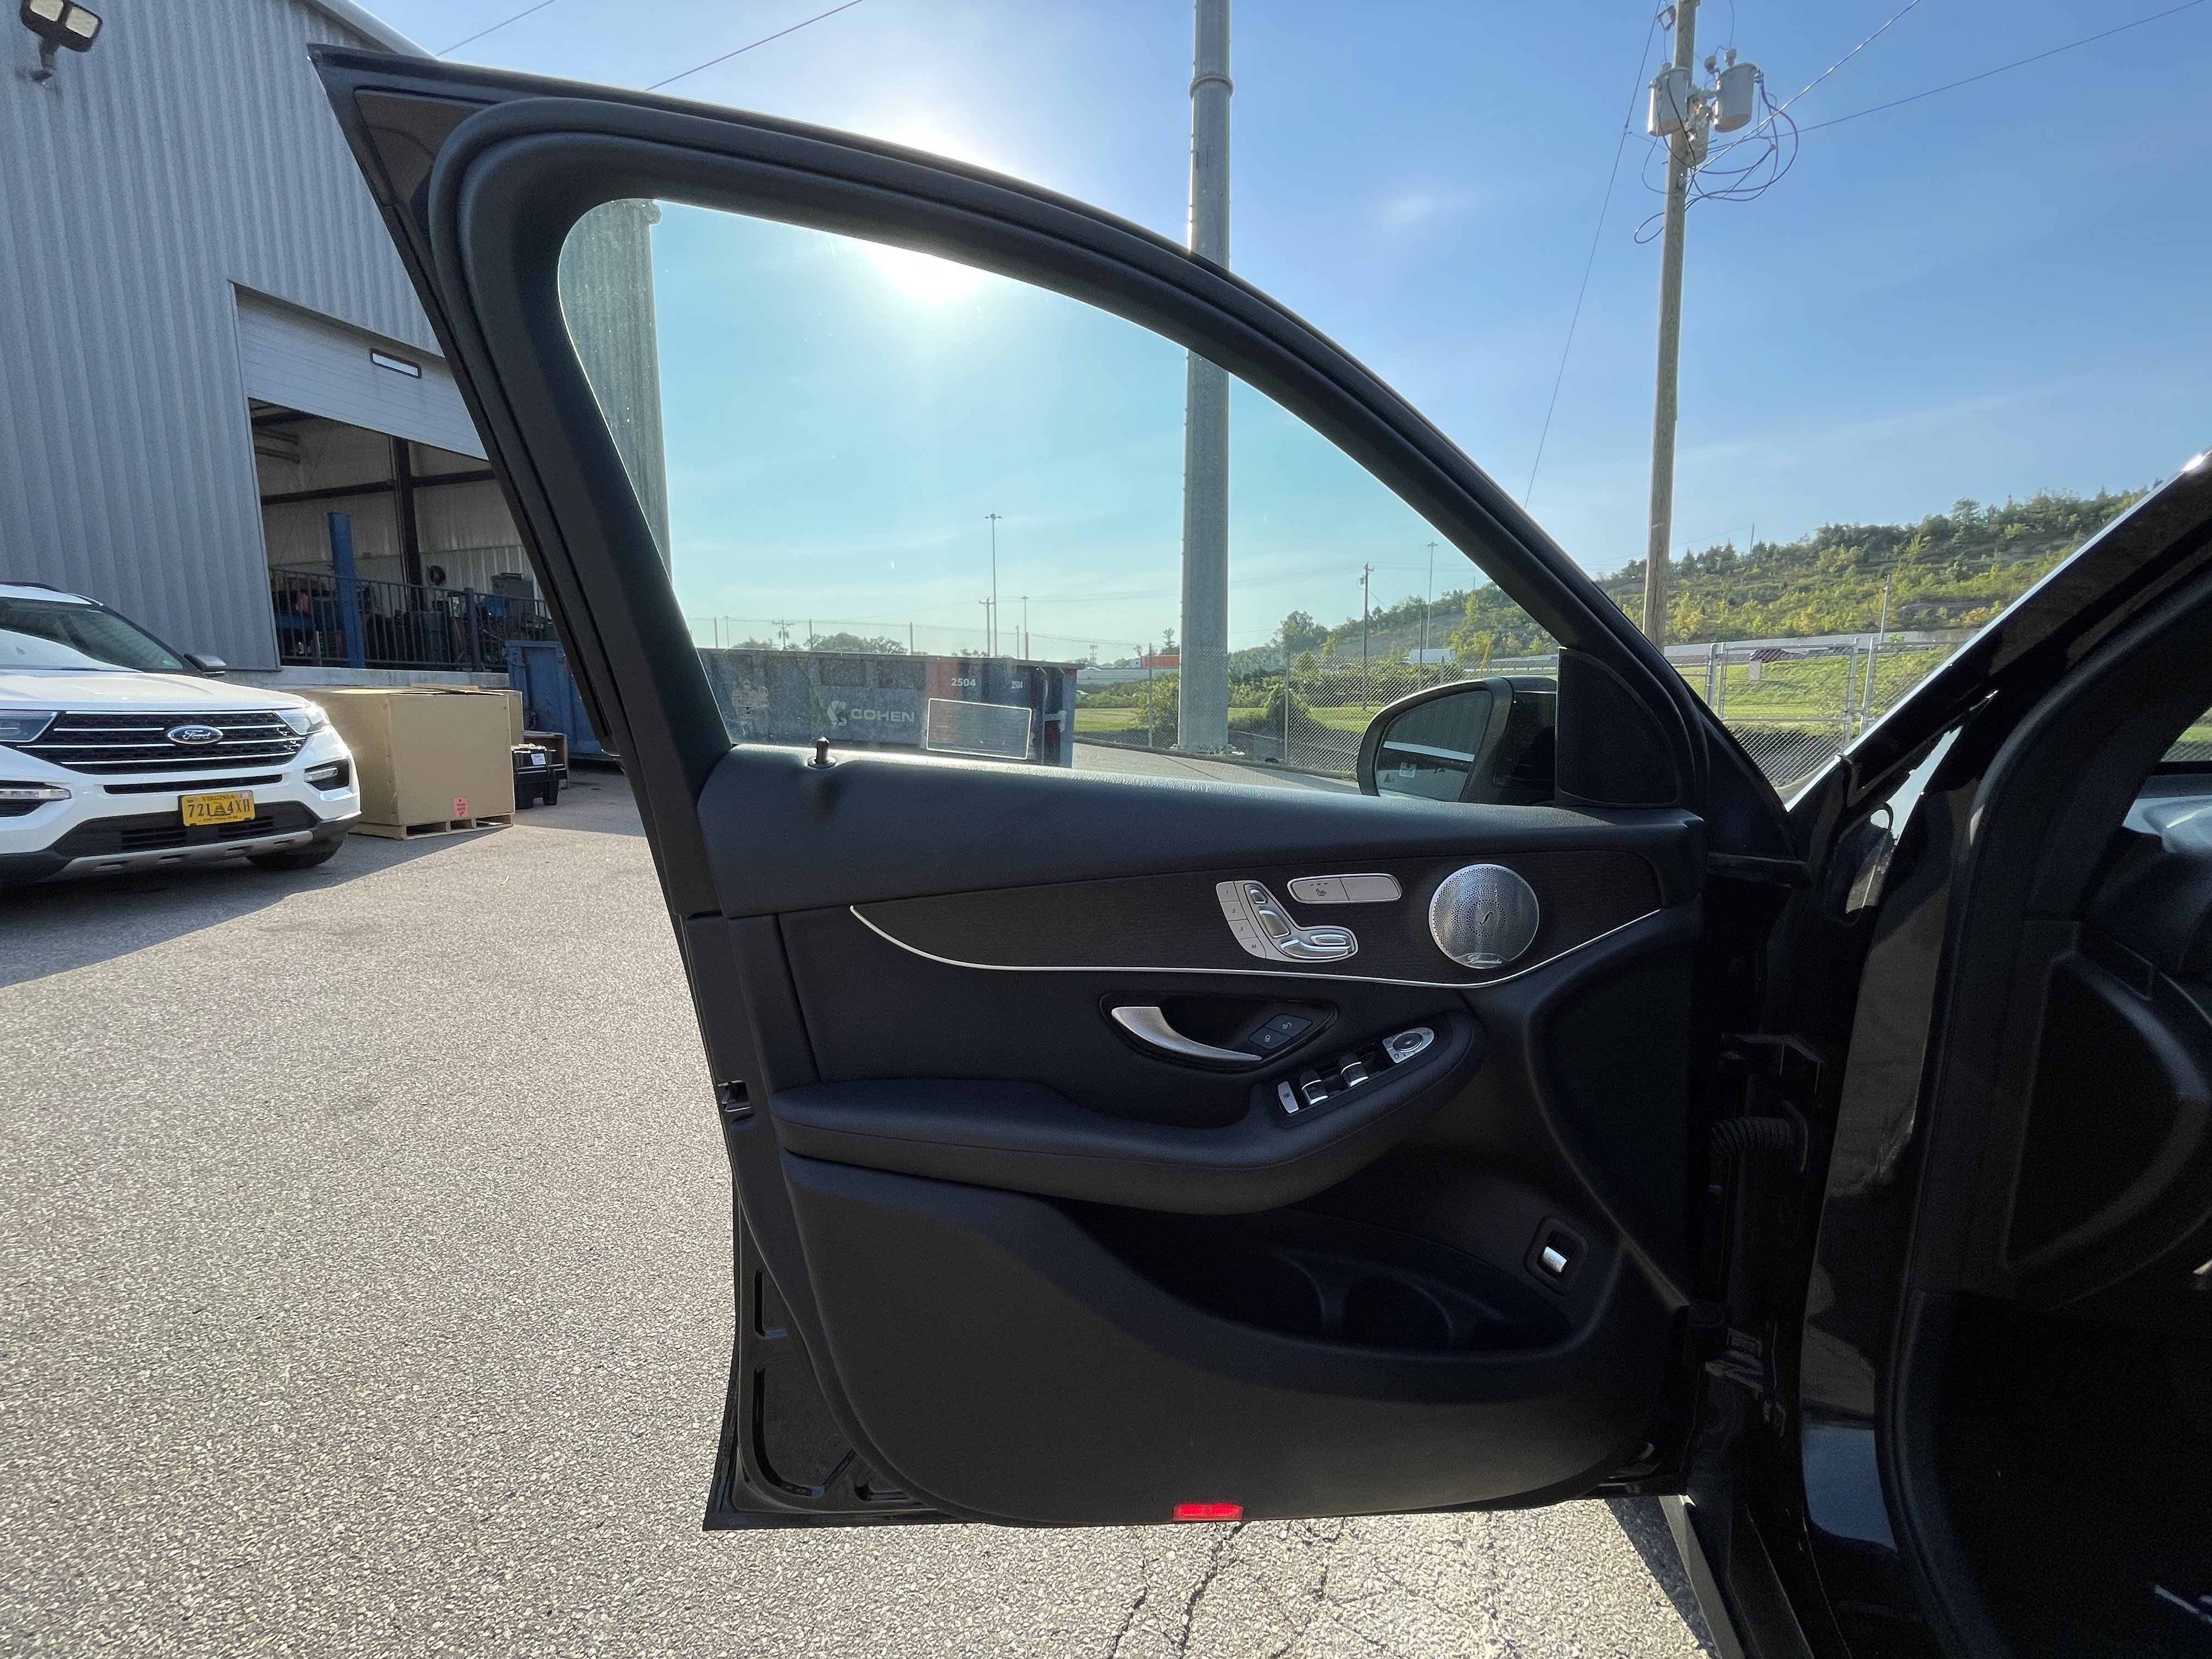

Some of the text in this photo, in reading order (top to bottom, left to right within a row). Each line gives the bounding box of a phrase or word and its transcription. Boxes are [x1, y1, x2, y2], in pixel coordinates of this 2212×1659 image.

[951, 678, 976, 687] 2504
[851, 708, 915, 722] COHEN
[183, 730, 211, 740] Ford
[188, 803, 210, 817] 721
